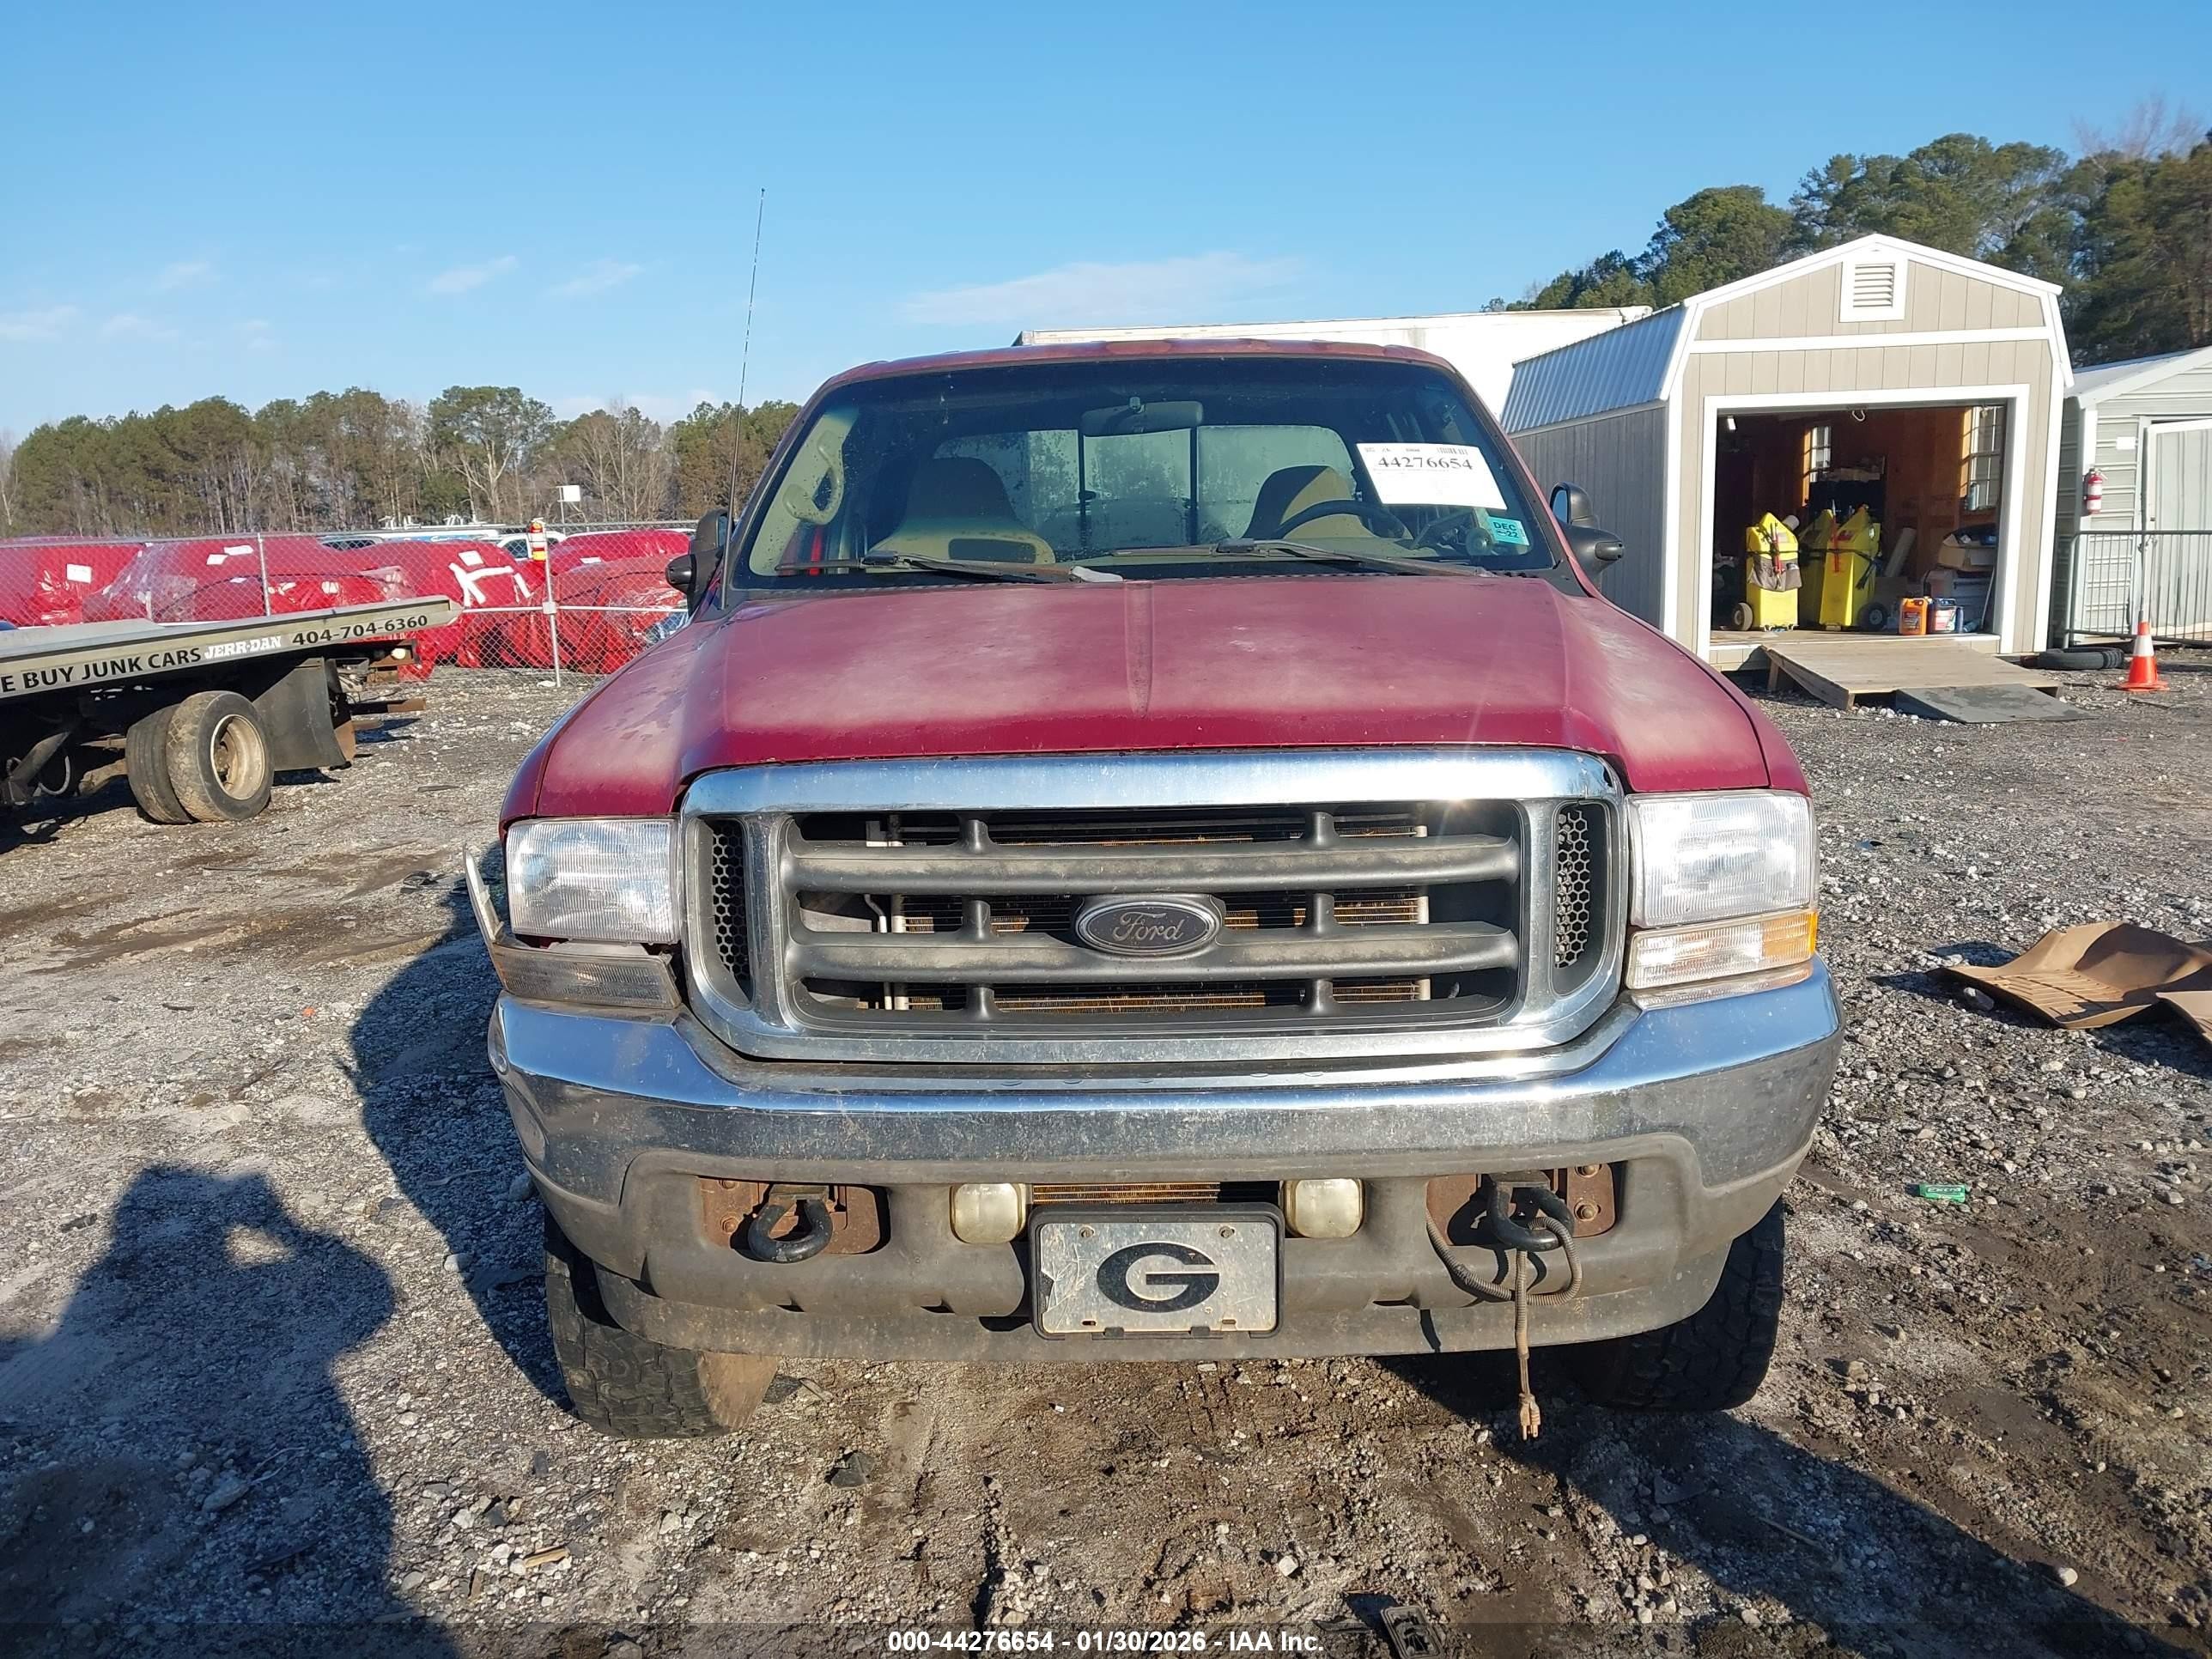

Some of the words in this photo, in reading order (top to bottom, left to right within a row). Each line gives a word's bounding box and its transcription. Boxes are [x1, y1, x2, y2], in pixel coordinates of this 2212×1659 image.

[1378, 456, 1474, 471] 44276654
[1492, 521, 1516, 531] DEC
[292, 615, 428, 645] 404-704-6360
[0, 675, 16, 693] E
[22, 665, 74, 689] BUY
[82, 656, 143, 681] JUNK
[148, 647, 202, 669] CARS
[1112, 911, 1185, 942] Ford
[1096, 1241, 1220, 1313] G
